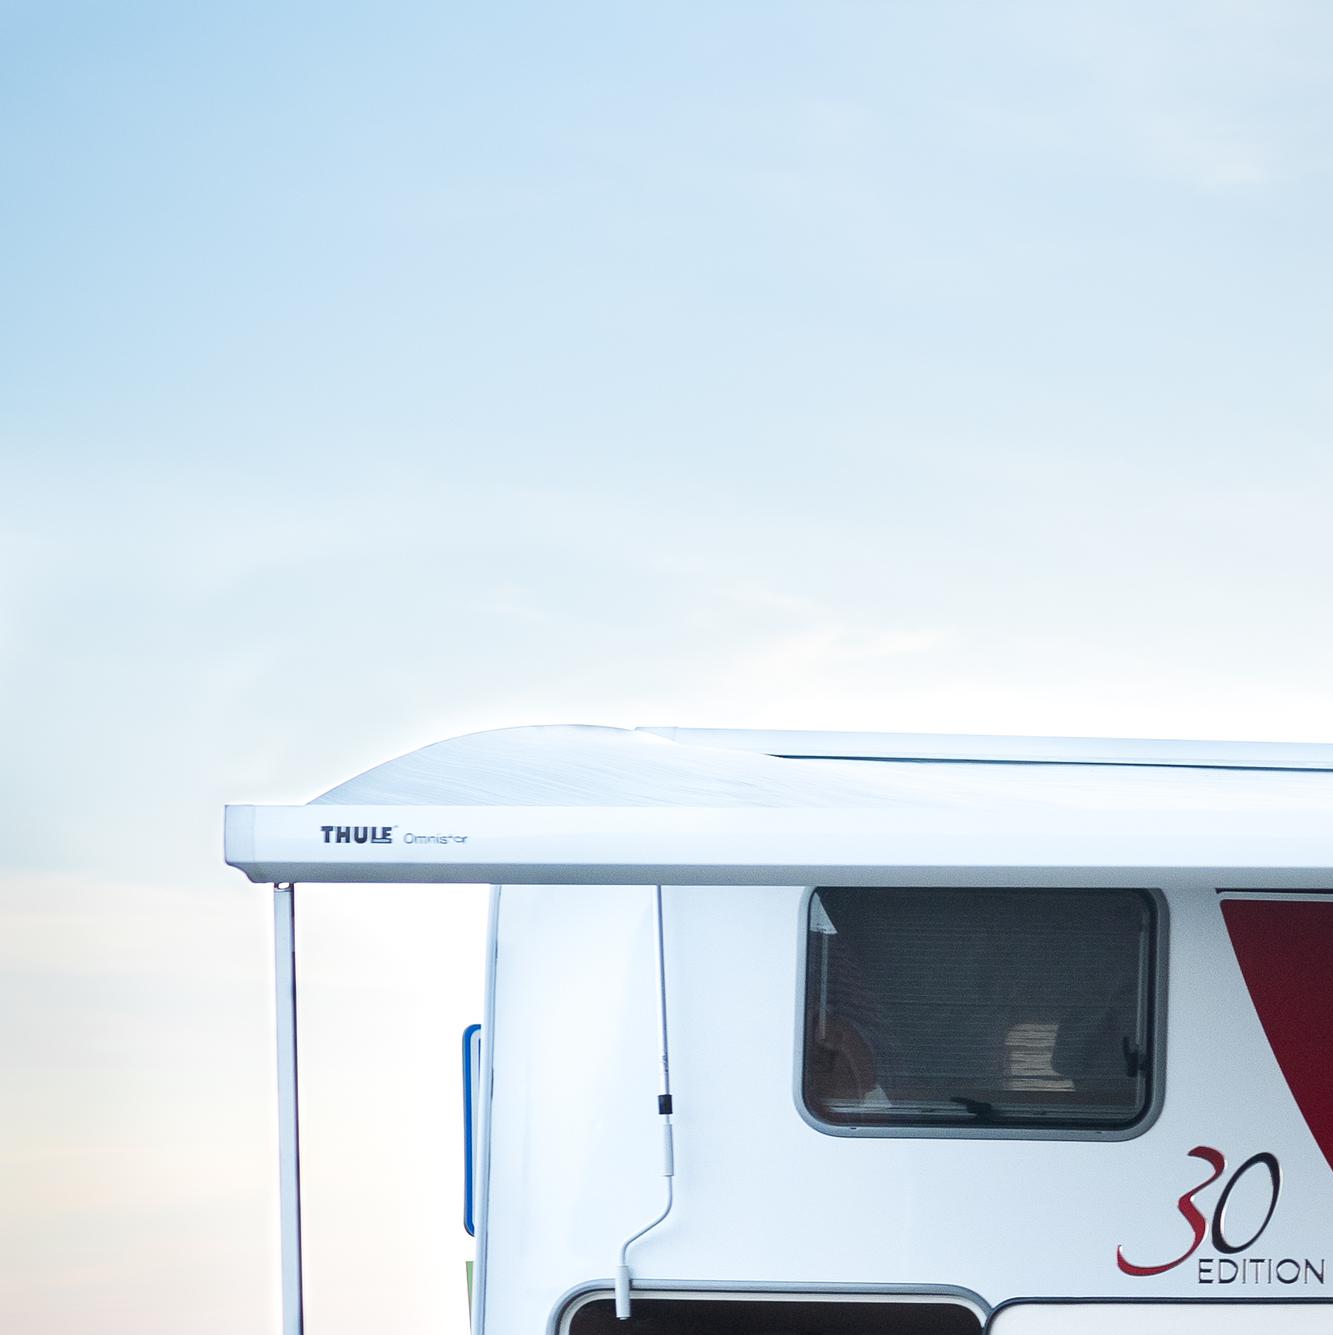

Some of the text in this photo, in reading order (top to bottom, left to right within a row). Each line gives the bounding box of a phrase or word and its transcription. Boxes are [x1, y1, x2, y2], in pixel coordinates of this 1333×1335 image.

[320, 825, 392, 844] THULE
[1117, 1145, 1280, 1276] 30
[1197, 1258, 1326, 1284] EDITION
